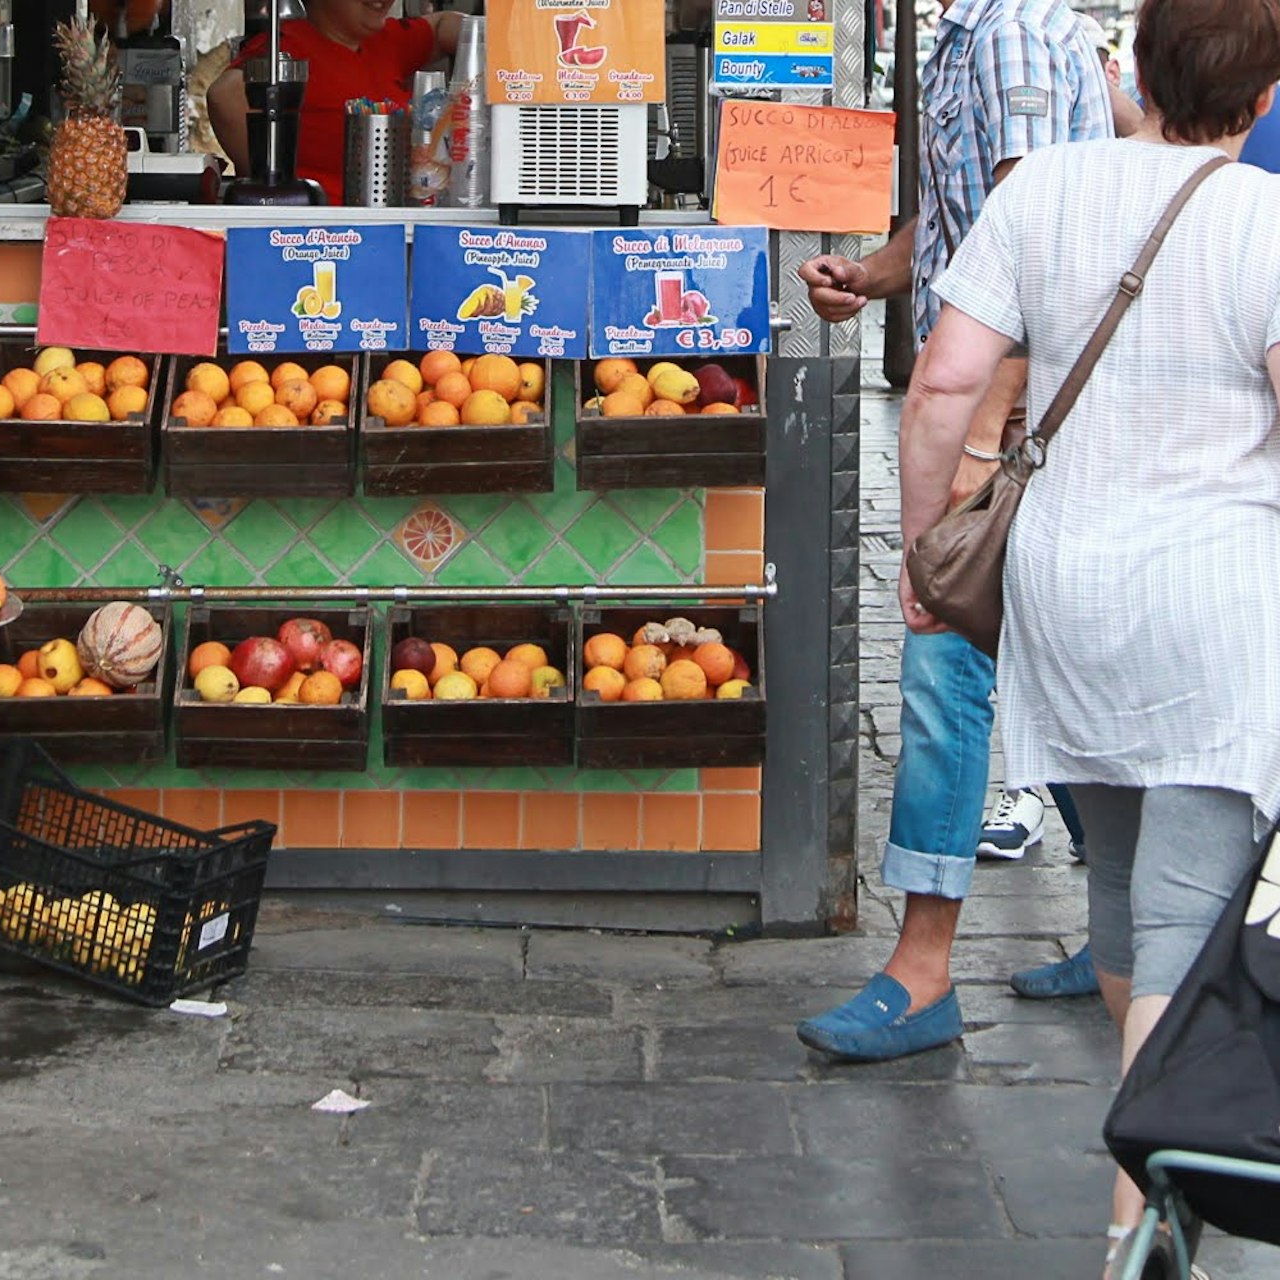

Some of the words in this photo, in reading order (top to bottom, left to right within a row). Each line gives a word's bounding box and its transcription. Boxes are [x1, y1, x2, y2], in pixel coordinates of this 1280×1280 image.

[743, 0, 756, 16] di
[758, 0, 794, 18] Stelle
[721, 29, 756, 47] Galak
[721, 59, 765, 80] Bounty
[728, 107, 796, 128] SUCCO
[271, 230, 304, 247] Succo
[459, 233, 492, 249] Succo
[495, 233, 547, 251] d'Ananas
[613, 236, 651, 253] Succo
[655, 235, 670, 252] di
[673, 235, 743, 254] Melograno
[282, 246, 320, 262] (Orange
[322, 246, 351, 261] Juice)
[465, 252, 512, 267] (Pineapple
[514, 253, 540, 268] Juice)
[626, 254, 693, 271] (Pomegranate
[695, 255, 726, 270] Juice)
[677, 330, 694, 347] €
[698, 329, 752, 349] 3,50
